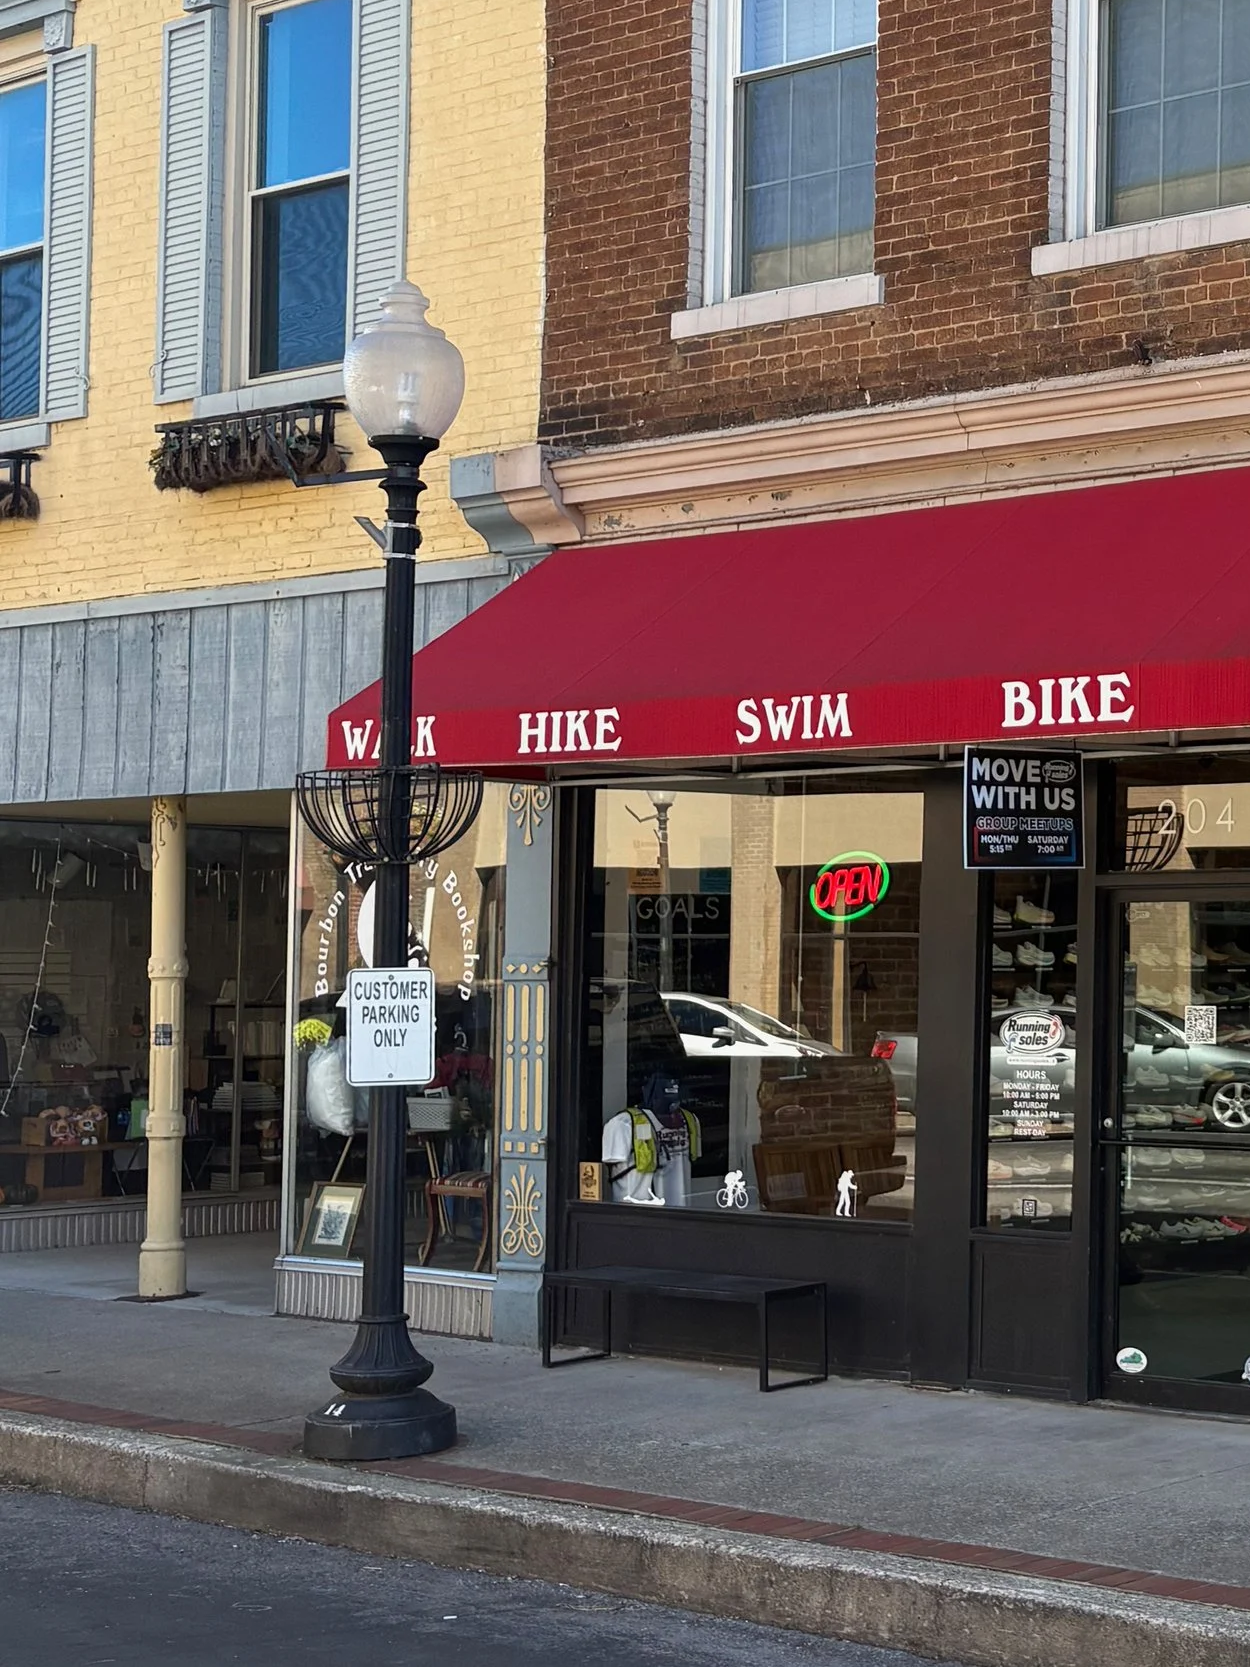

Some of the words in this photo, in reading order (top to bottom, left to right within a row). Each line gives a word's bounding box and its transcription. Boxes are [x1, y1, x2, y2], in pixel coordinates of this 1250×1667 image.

[1001, 672, 1135, 728] BIKE
[735, 692, 853, 745] SWIM
[341, 715, 436, 760] WK
[518, 706, 622, 754] HIKE
[972, 757, 1041, 783] MOVE
[971, 785, 1036, 810] WITH
[1043, 788, 1076, 811] US
[976, 816, 1018, 831] GROUP
[1019, 817, 1074, 831] MEETUPS
[1157, 798, 1235, 835] 204
[980, 834, 1019, 845] MON/THU
[1027, 835, 1069, 844] SATURDAY
[989, 844, 1005, 854] 5:15
[1037, 845, 1055, 854] 7:00
[815, 864, 882, 909] OPEN
[636, 896, 720, 920] GOALS
[314, 889, 346, 998] Bourbon
[442, 869, 480, 1002] Bookshop
[354, 980, 428, 1001] CUSTOMER
[362, 1004, 420, 1025] PARKING
[1007, 1018, 1051, 1034] Running
[373, 1028, 408, 1048] ONLY
[1018, 1032, 1049, 1046] soles
[1016, 1069, 1047, 1080] HOURS
[1003, 1082, 1031, 1090] MONDAY
[1035, 1083, 1060, 1091] FRIDAY
[1020, 1091, 1031, 1099] AM
[1050, 1092, 1060, 1100] PM
[1013, 1100, 1049, 1109] SATURDAY
[1019, 1109, 1030, 1117] AM
[1049, 1110, 1060, 1119] PM
[1016, 1119, 1044, 1127] SUNDAY
[1014, 1128, 1031, 1136] REST
